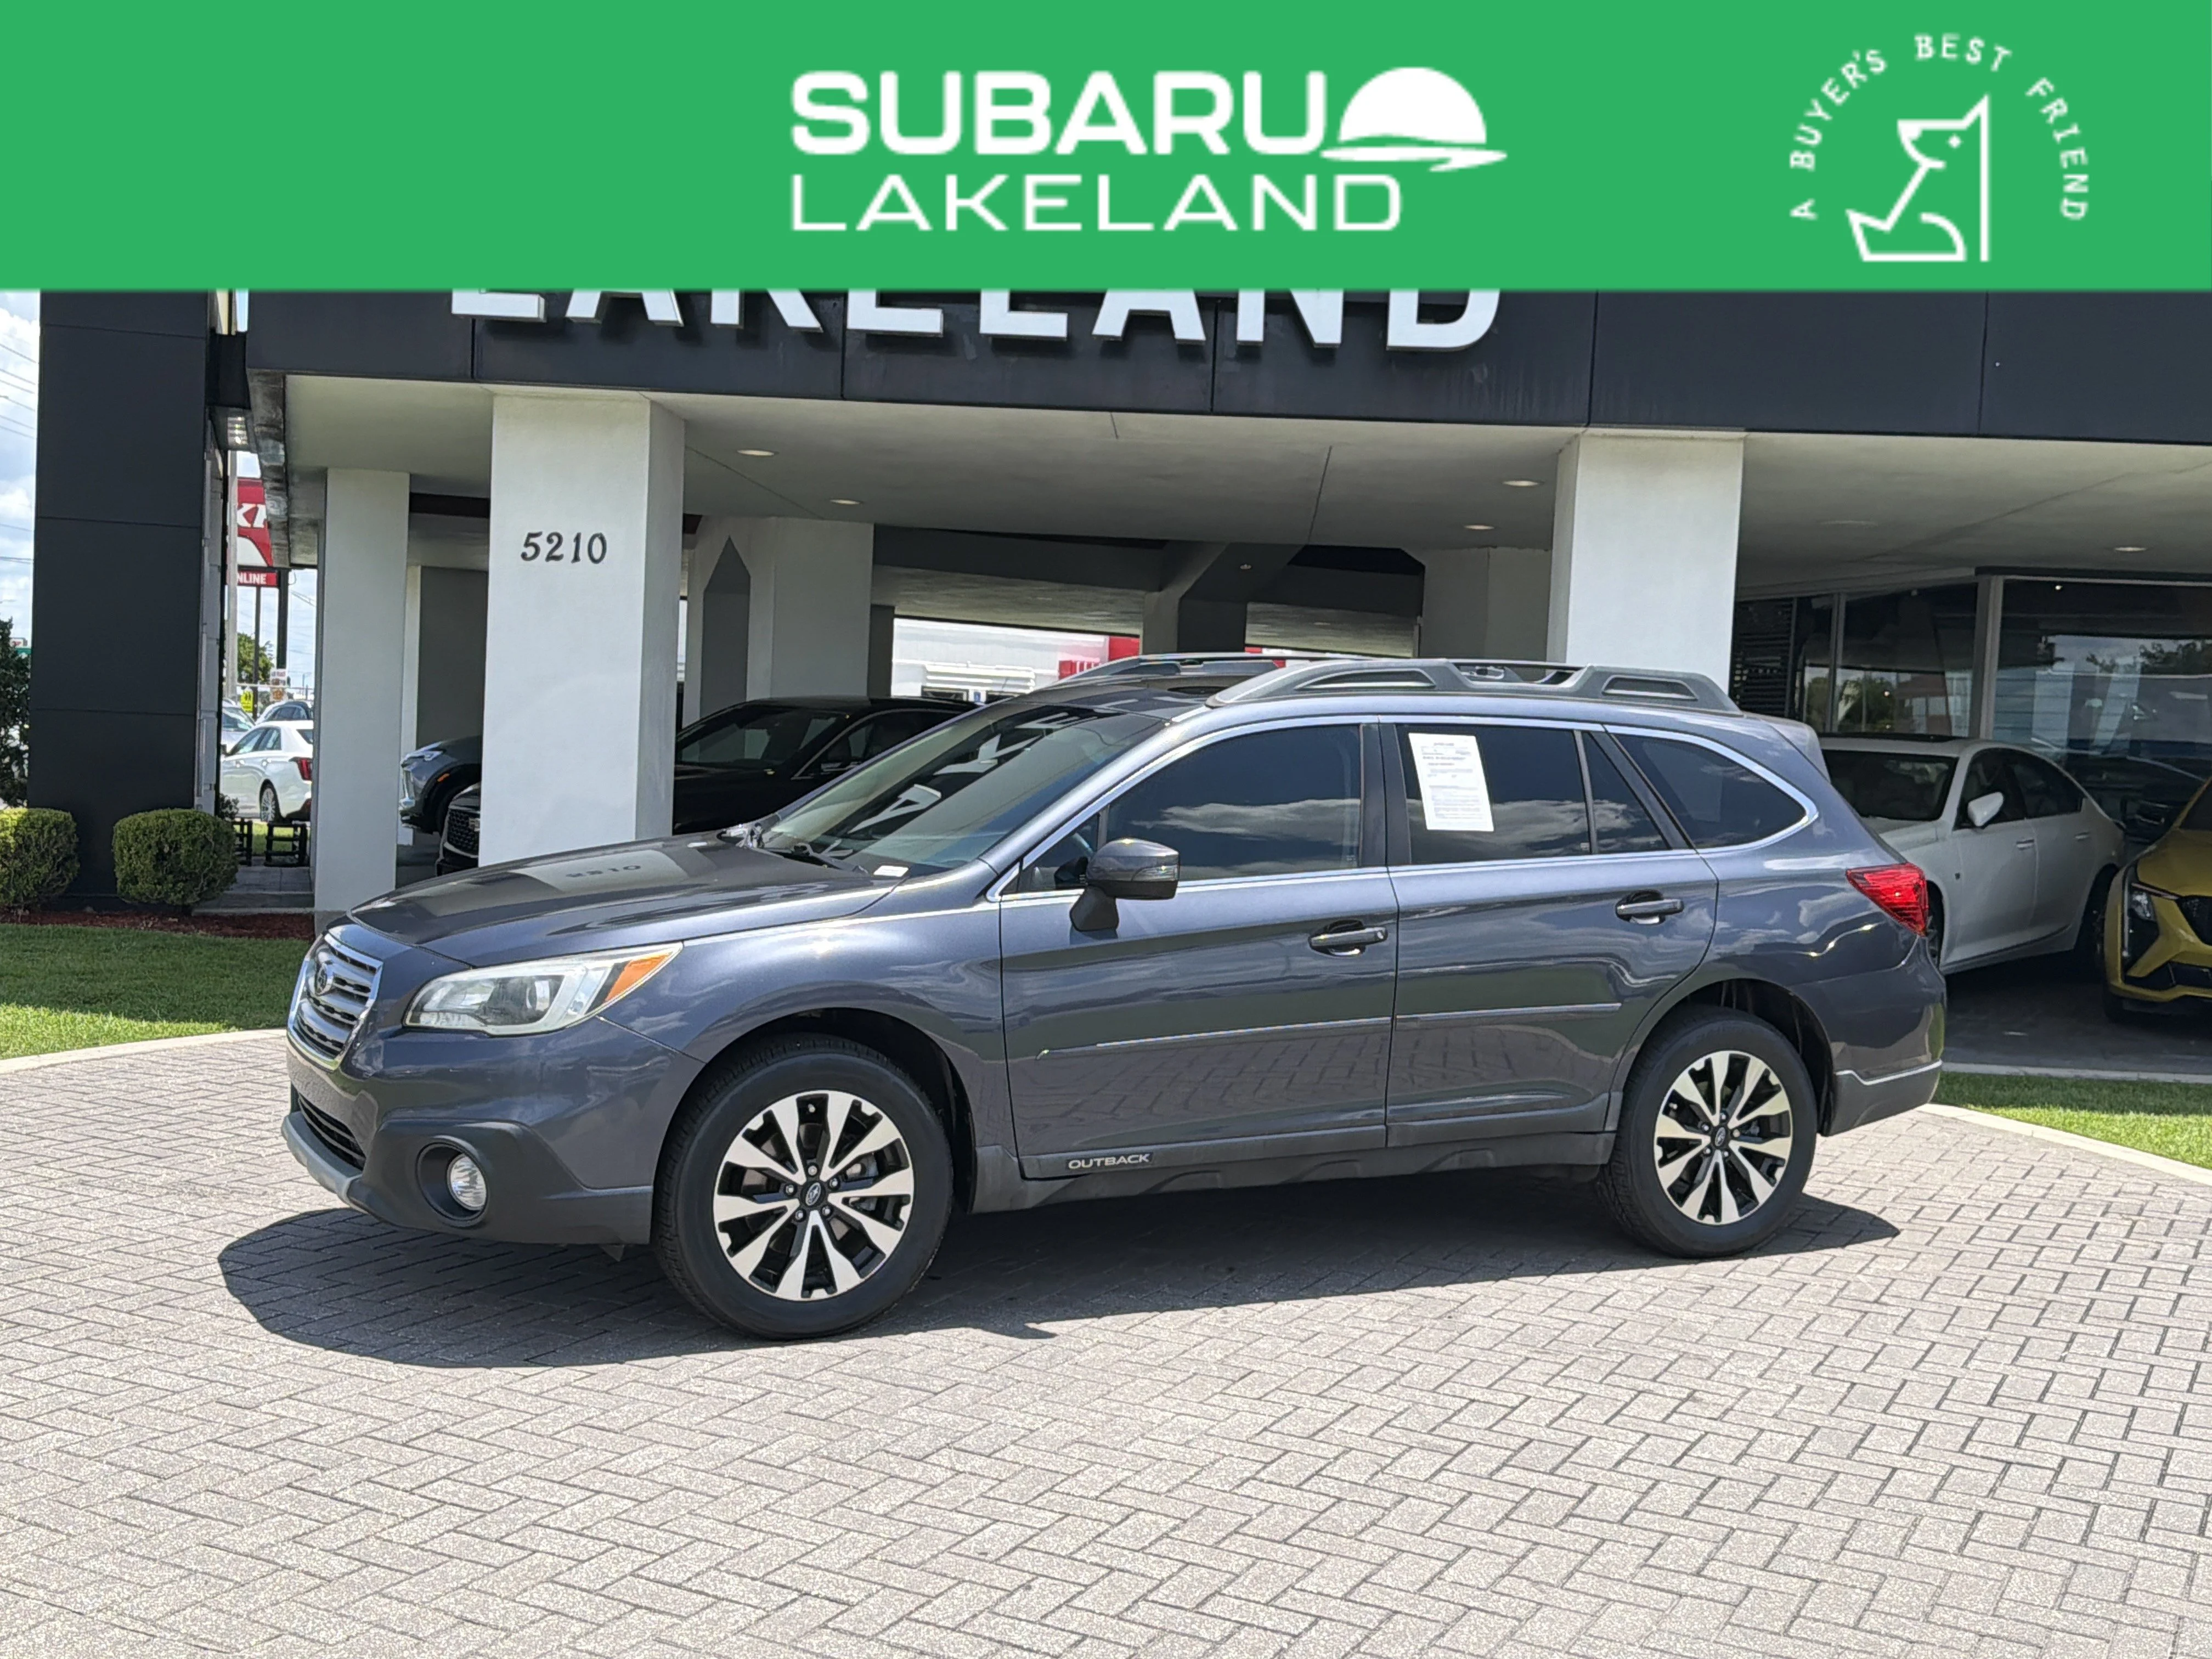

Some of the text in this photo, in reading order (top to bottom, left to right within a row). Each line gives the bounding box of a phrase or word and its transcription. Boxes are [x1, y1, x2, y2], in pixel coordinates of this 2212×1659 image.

[521, 532, 607, 564] 5210
[236, 572, 267, 584] NLINE
[1068, 1154, 1150, 1169] OUTBACK
